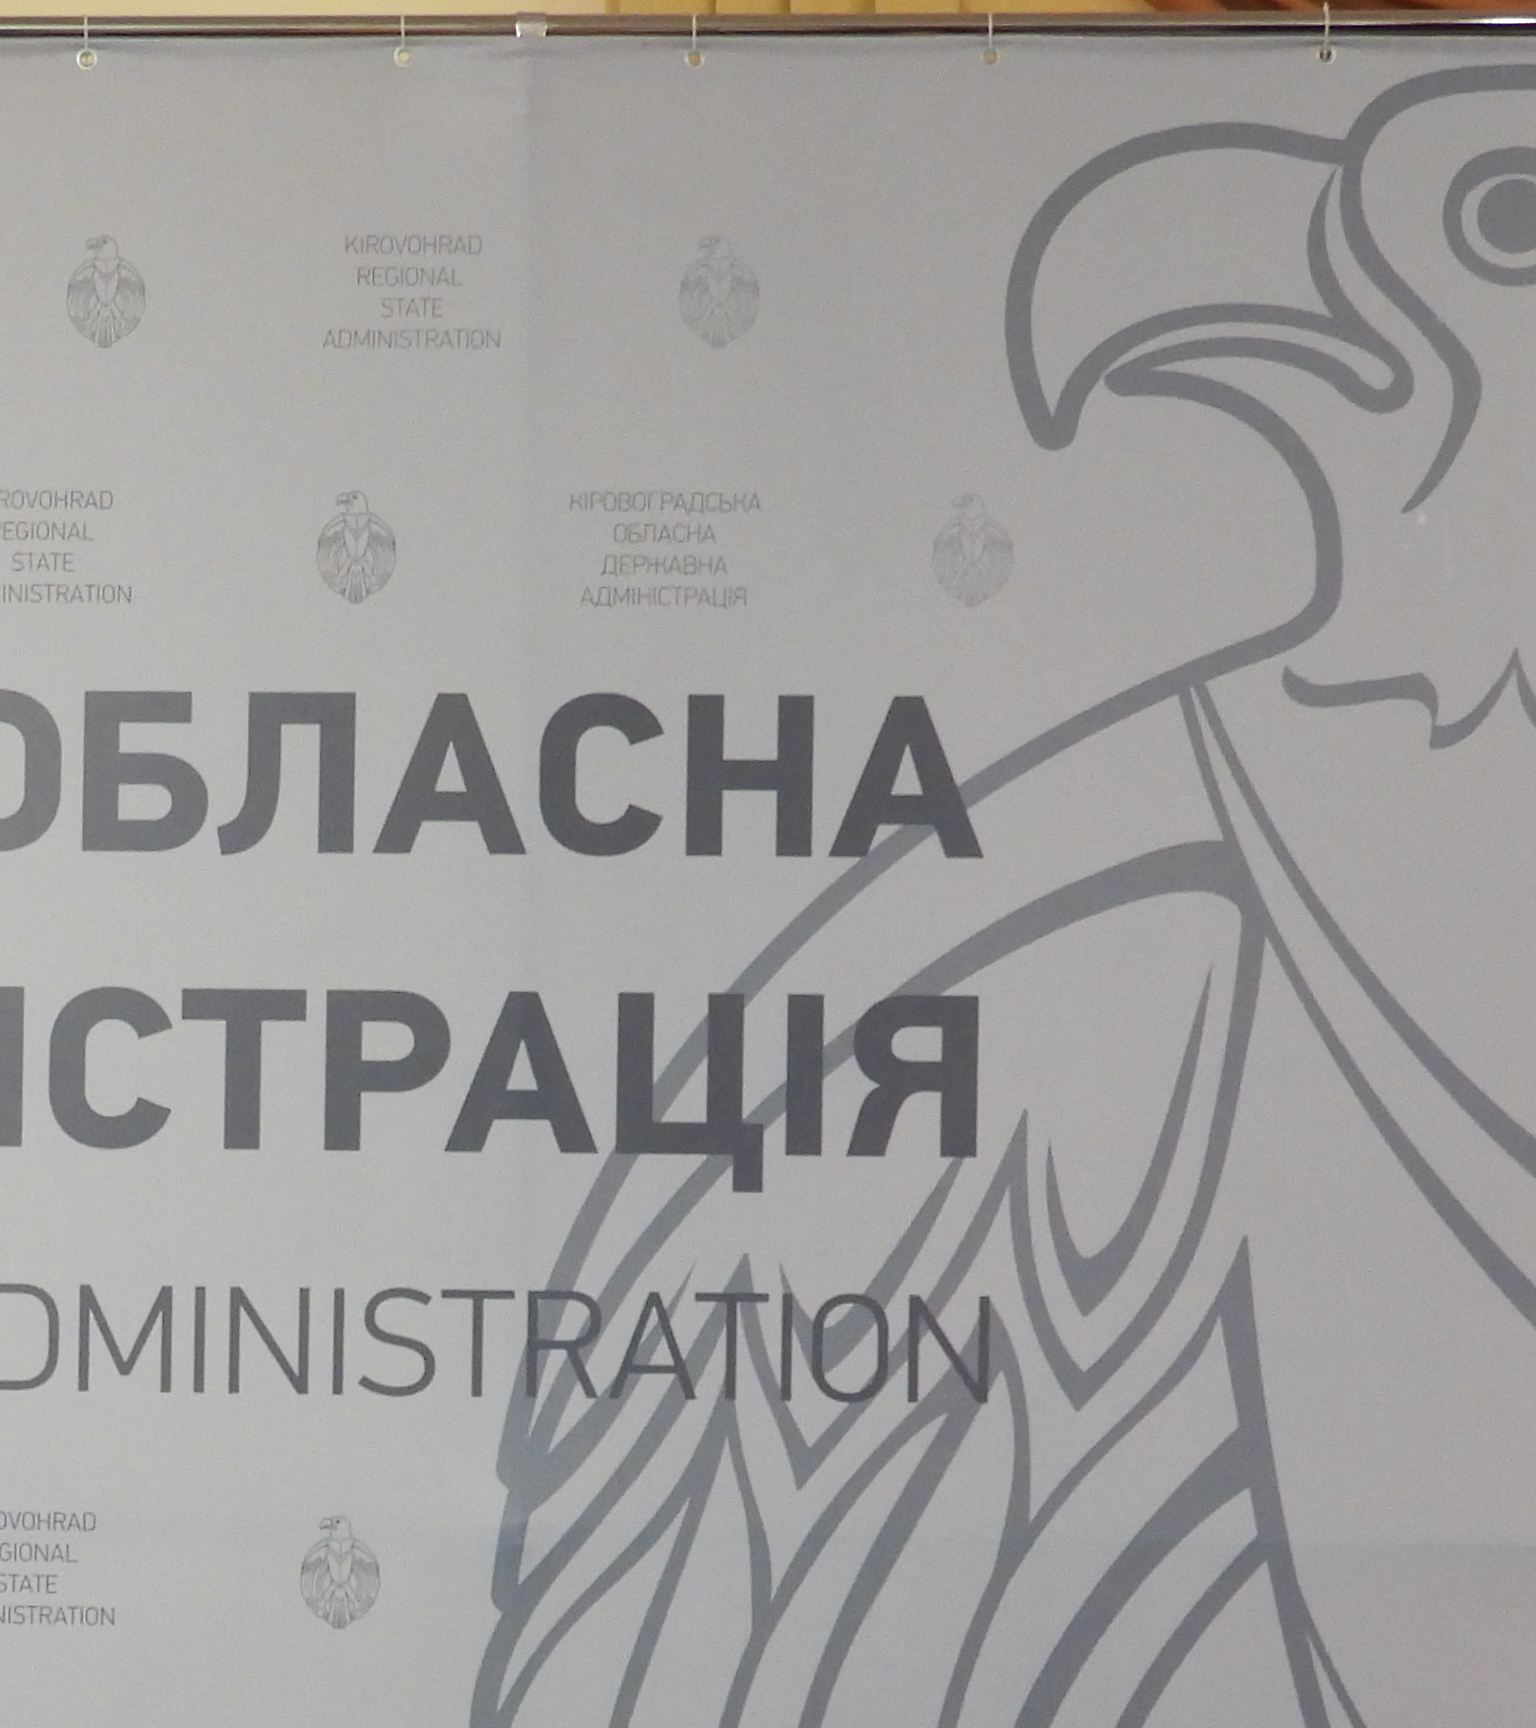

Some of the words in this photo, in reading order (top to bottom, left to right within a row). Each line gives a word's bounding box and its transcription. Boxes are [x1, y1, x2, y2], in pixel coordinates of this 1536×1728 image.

[344, 234, 483, 255] KIROVOHRAD
[356, 266, 462, 287] REGIONAL
[381, 296, 442, 318] STATE
[322, 328, 501, 350] ADMINISTRATION
[569, 491, 762, 515] КІРОВОГРАДСЬКА
[613, 522, 716, 544] ОБЛАСНА
[12, 551, 74, 573] STATE
[600, 554, 728, 578] ДЕРЖАВНА
[580, 585, 748, 609] АДМІНІСТРАЦІЯ
